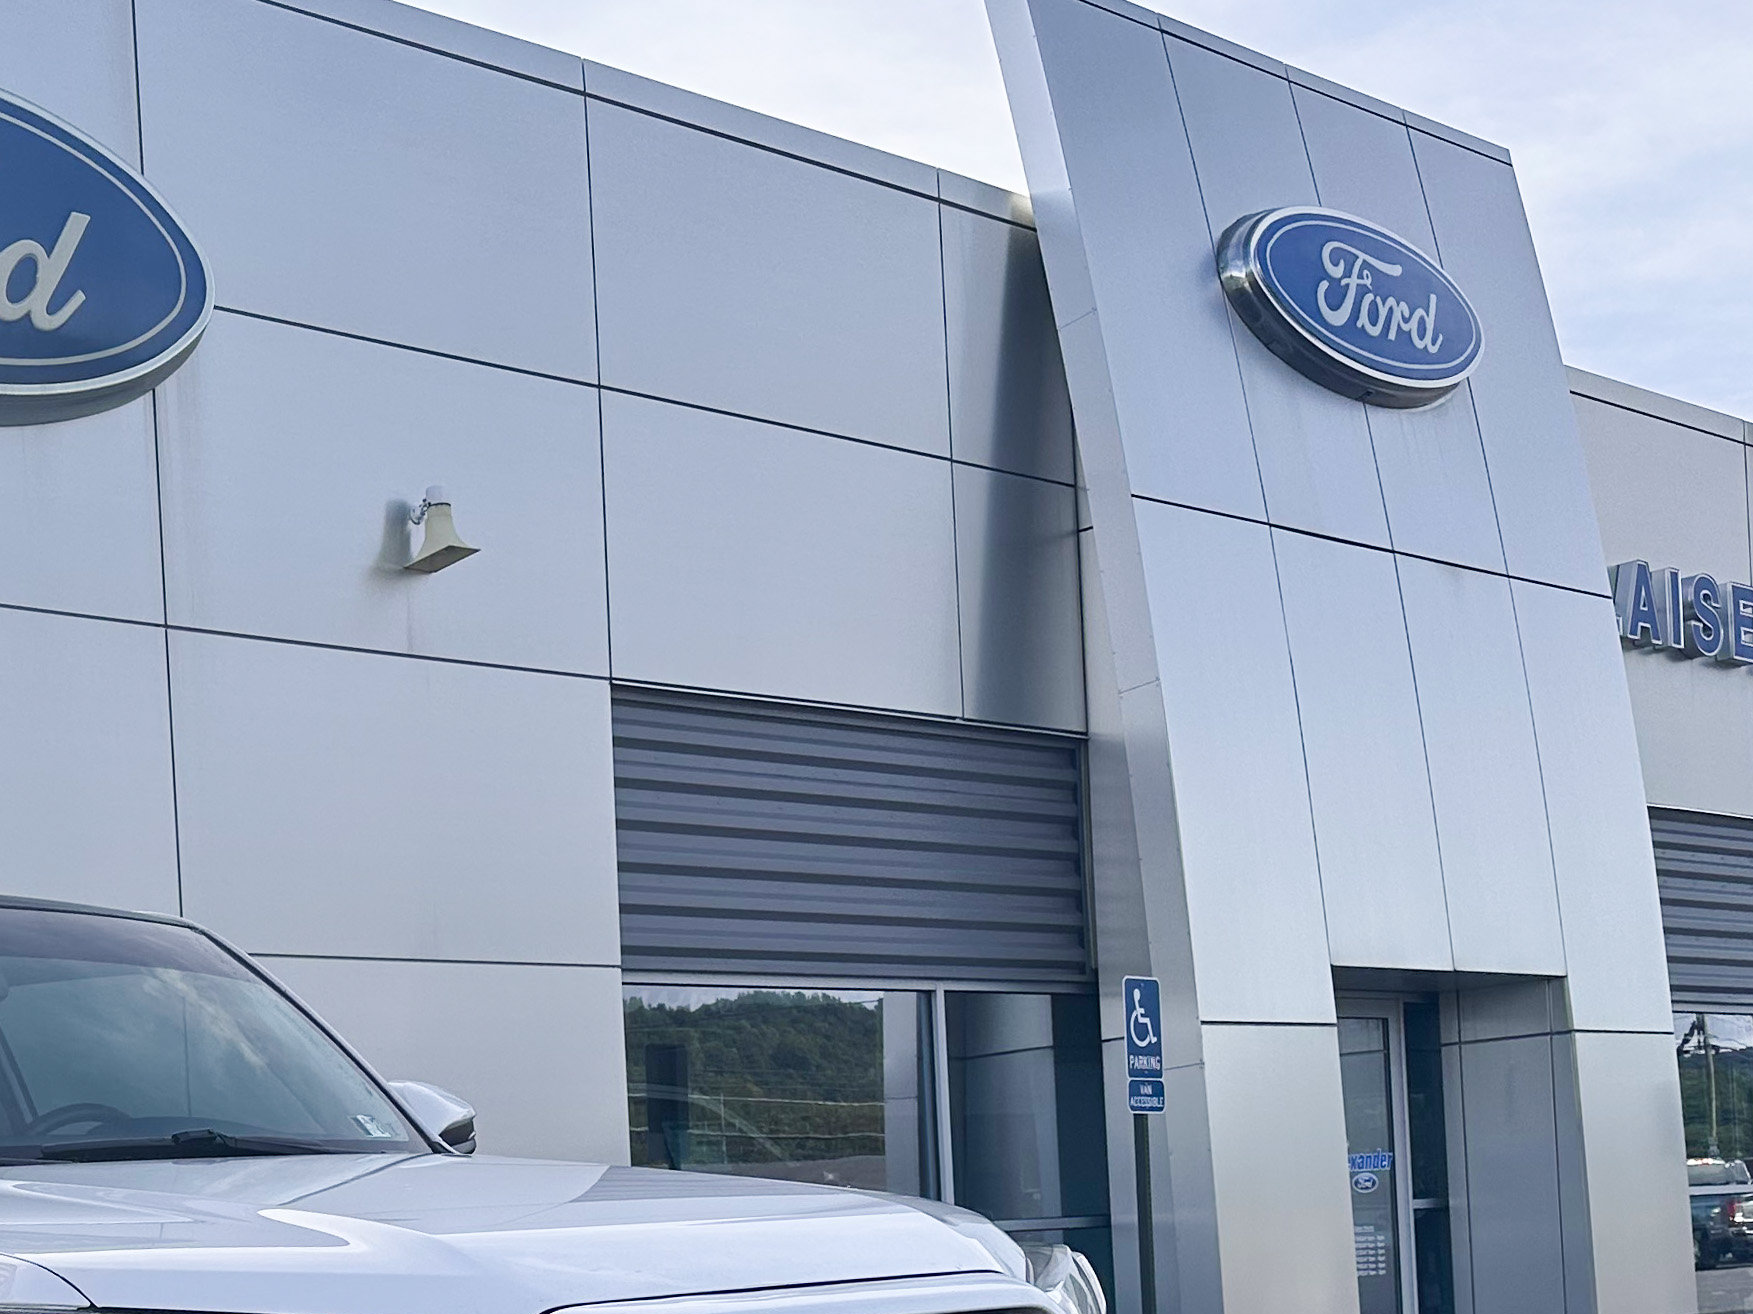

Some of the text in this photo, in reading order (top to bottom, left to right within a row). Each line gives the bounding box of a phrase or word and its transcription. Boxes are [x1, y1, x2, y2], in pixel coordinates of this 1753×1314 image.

[1316, 240, 1443, 354] Ford
[1614, 559, 1753, 664] AISE
[1129, 1055, 1160, 1070] PARKING
[1140, 1084, 1152, 1095] VAN
[1130, 1096, 1164, 1107] ACCESSIBLE
